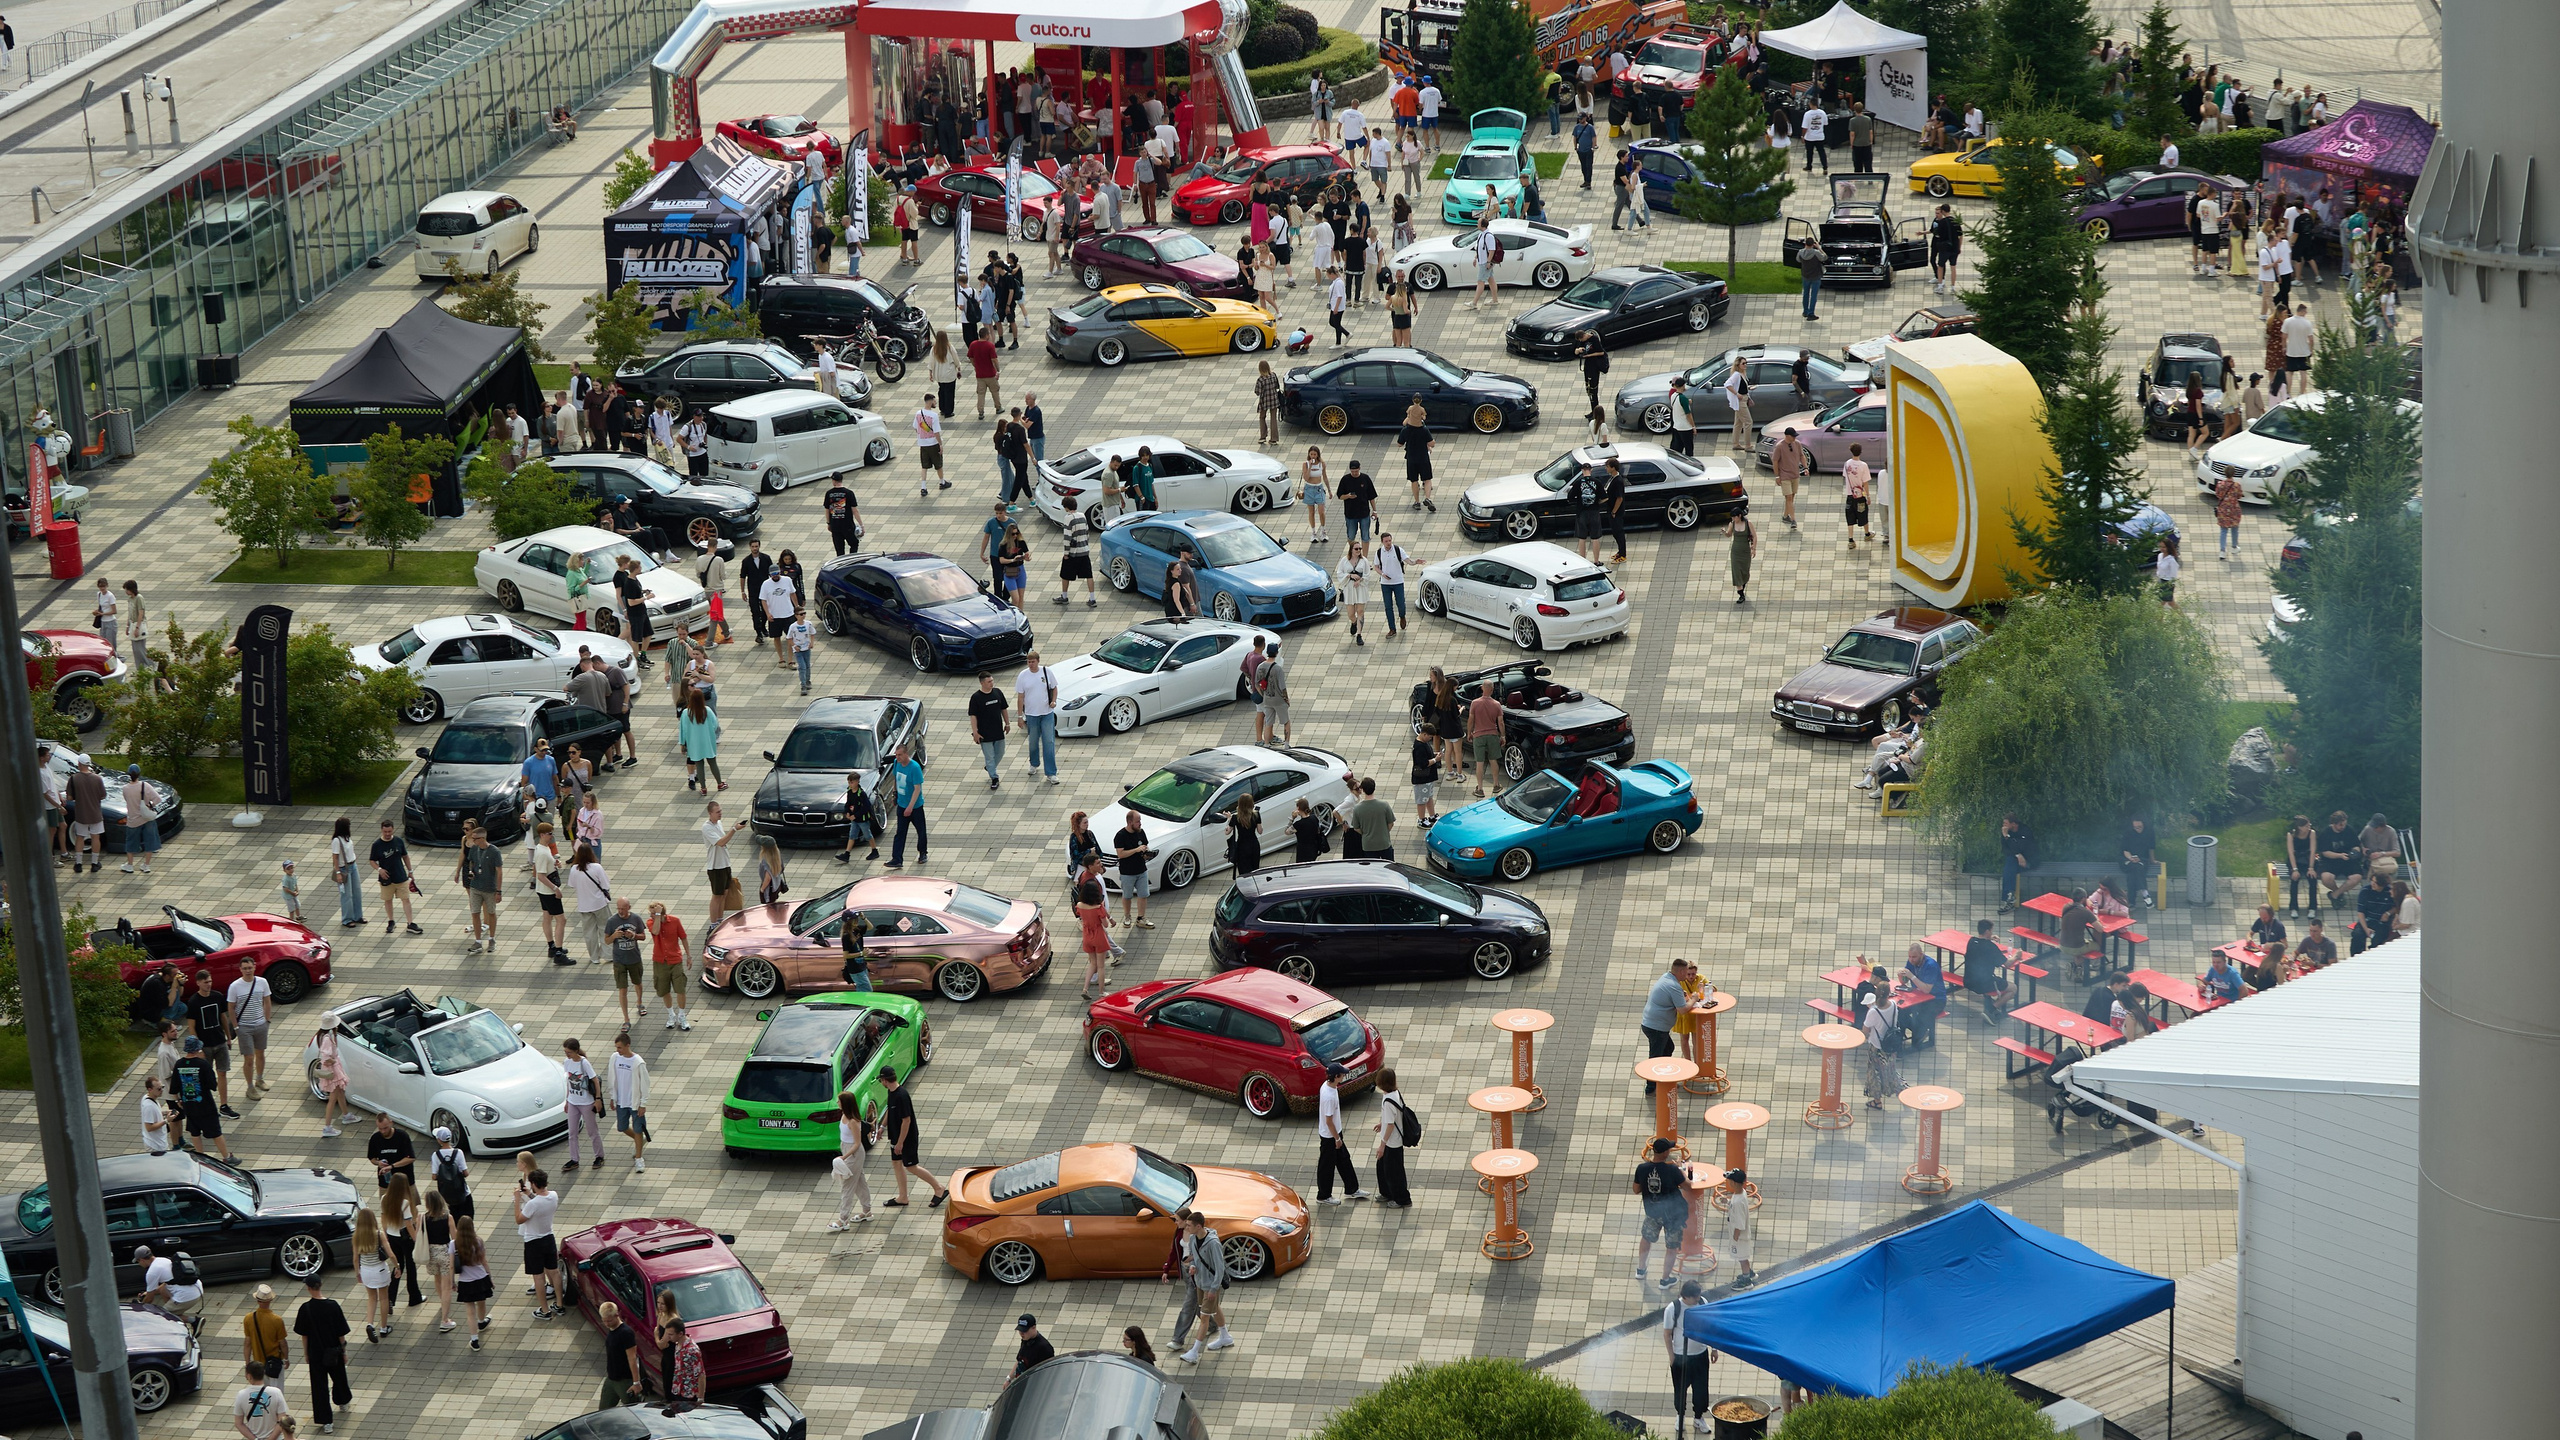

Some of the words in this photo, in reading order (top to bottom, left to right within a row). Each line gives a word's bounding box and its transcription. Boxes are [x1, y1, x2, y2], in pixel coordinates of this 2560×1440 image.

[1030, 23, 1091, 38] auto.ru
[1425, 21, 1459, 31] KASPAD
[1536, 28, 1569, 52] KASPADO
[1557, 36, 1578, 60] 777
[1579, 31, 1593, 51] 00
[1595, 23, 1609, 45] 66
[1428, 62, 1455, 72] SCANIA
[1880, 59, 1914, 89] GEAR
[651, 199, 710, 210] BULLDOZER
[614, 223, 649, 231] BULLDOZER
[625, 259, 723, 278] BULLDOZER
